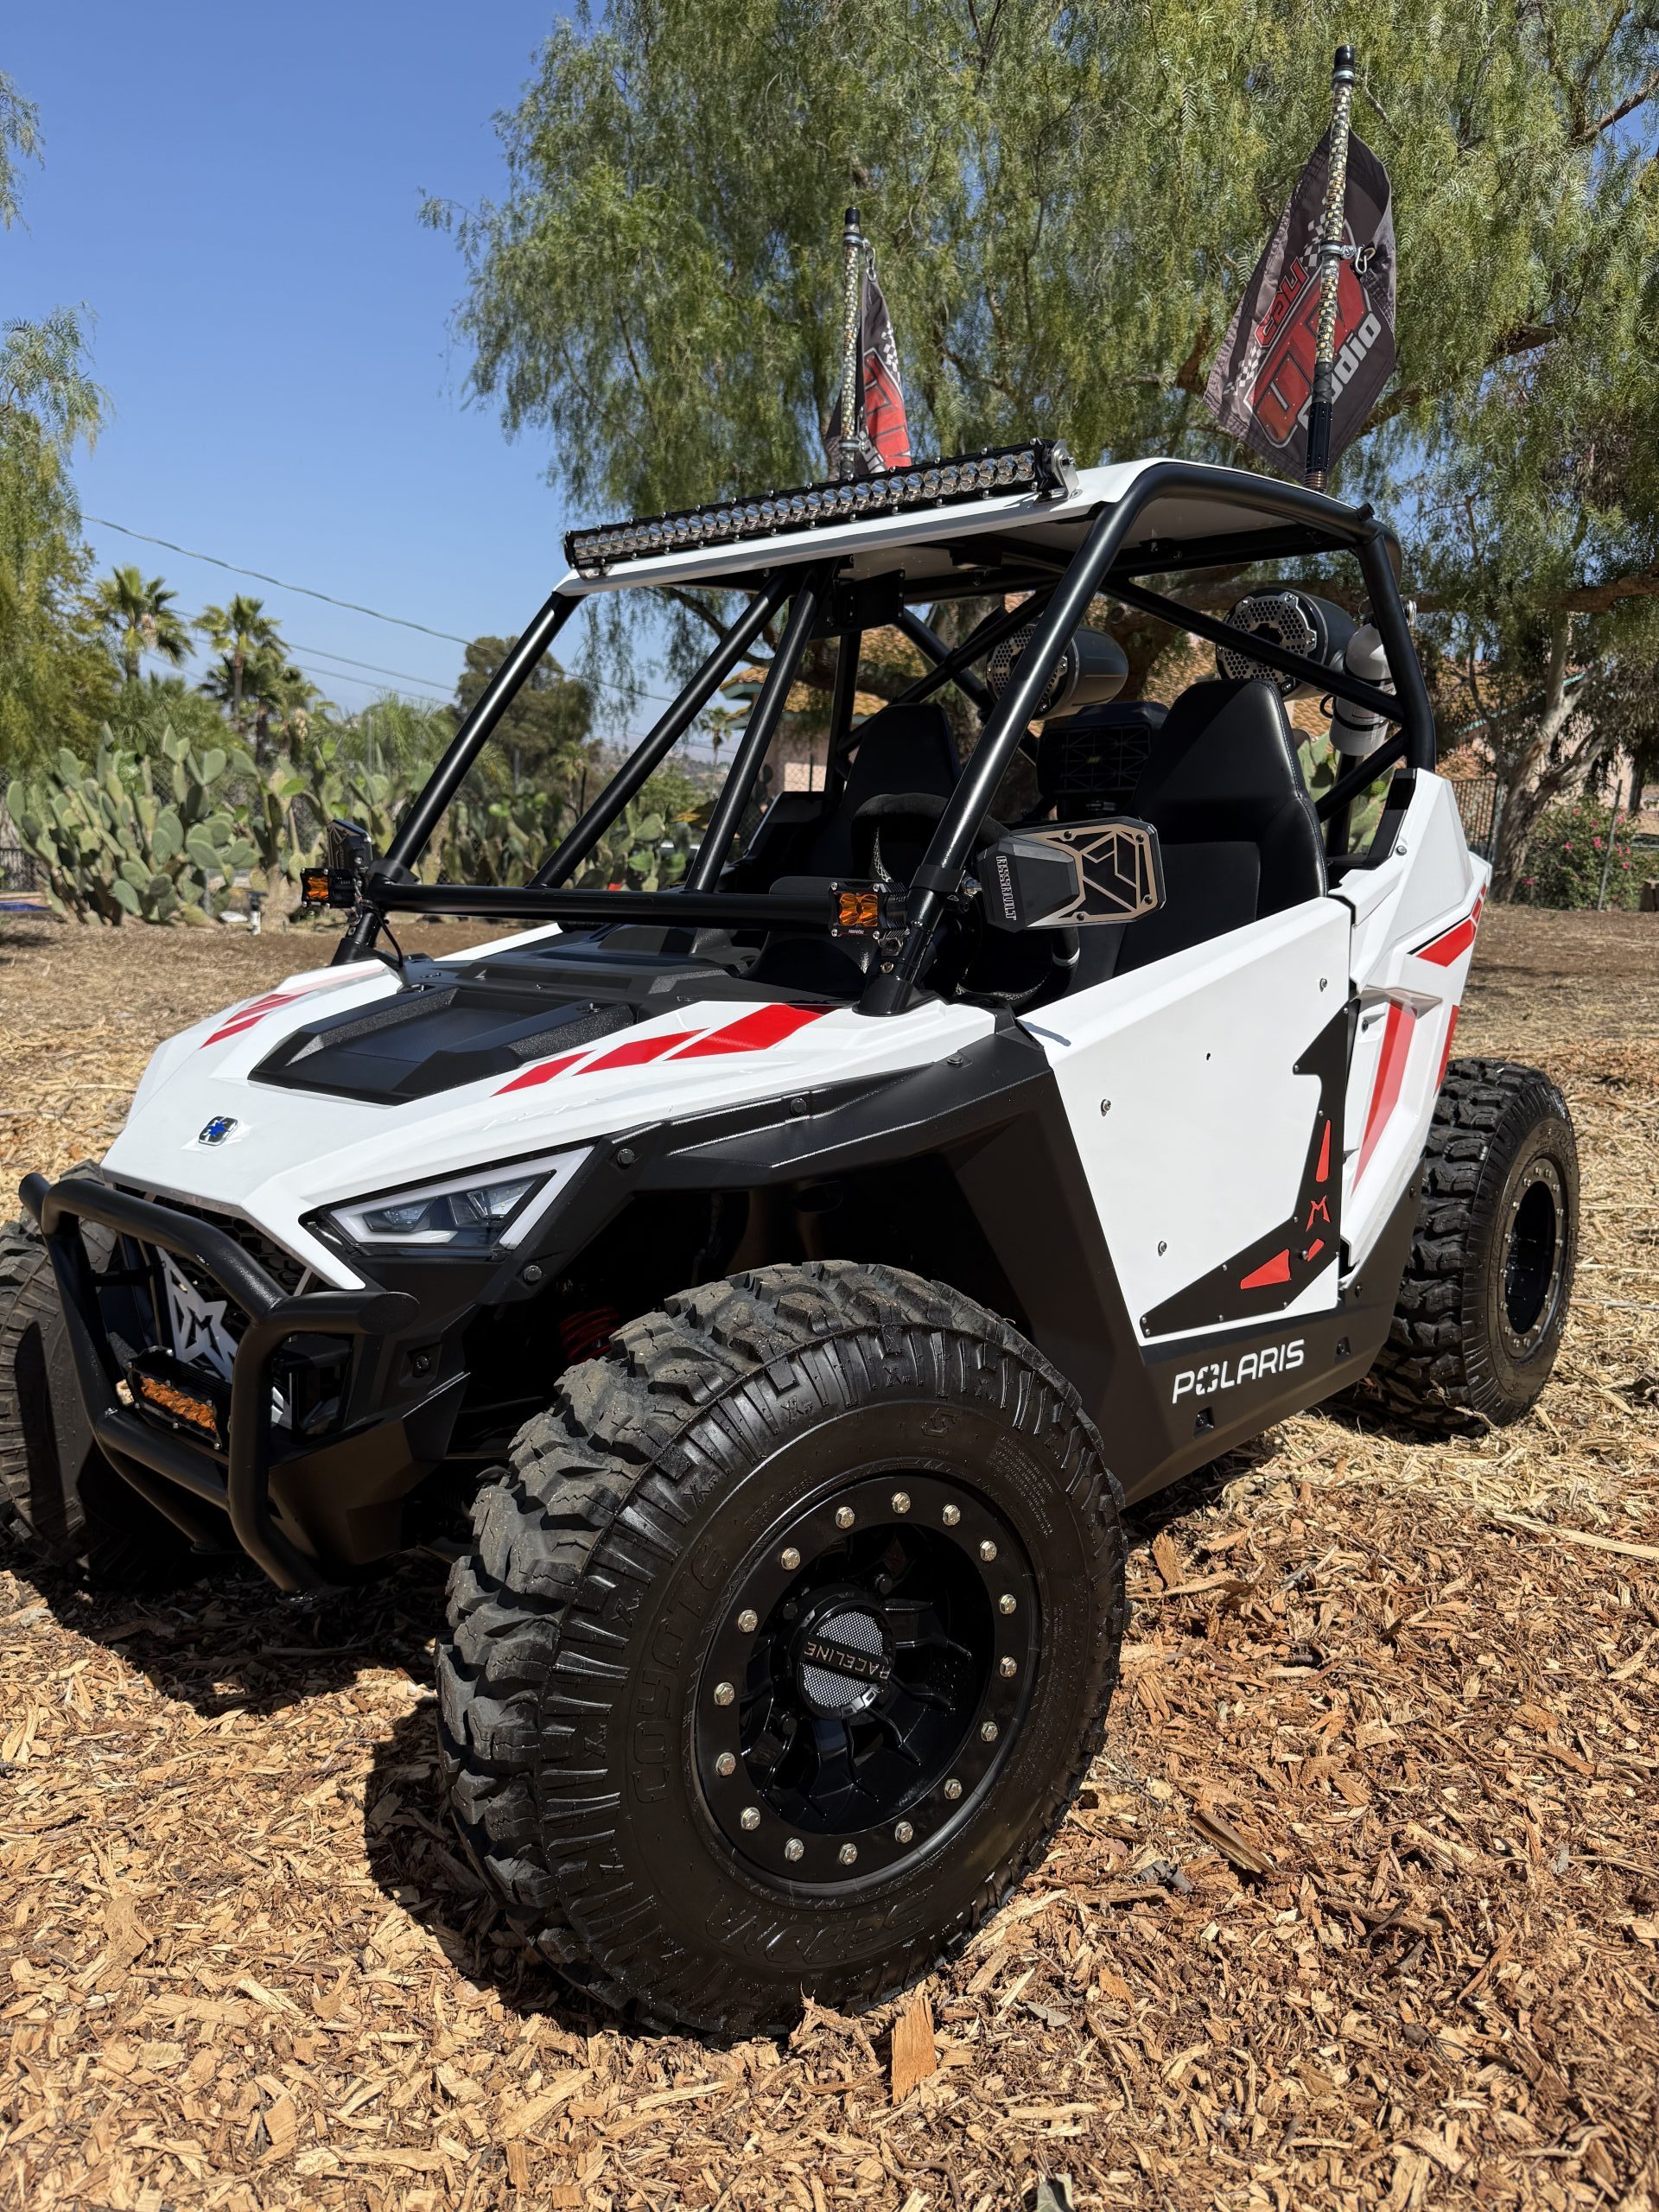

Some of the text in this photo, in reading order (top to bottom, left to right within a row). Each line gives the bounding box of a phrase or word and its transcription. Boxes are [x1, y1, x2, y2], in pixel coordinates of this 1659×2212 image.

[995, 855, 1017, 921] ASSAULT
[1172, 1338, 1305, 1404] POLARIS
[803, 1640, 892, 1681] RACELINE
